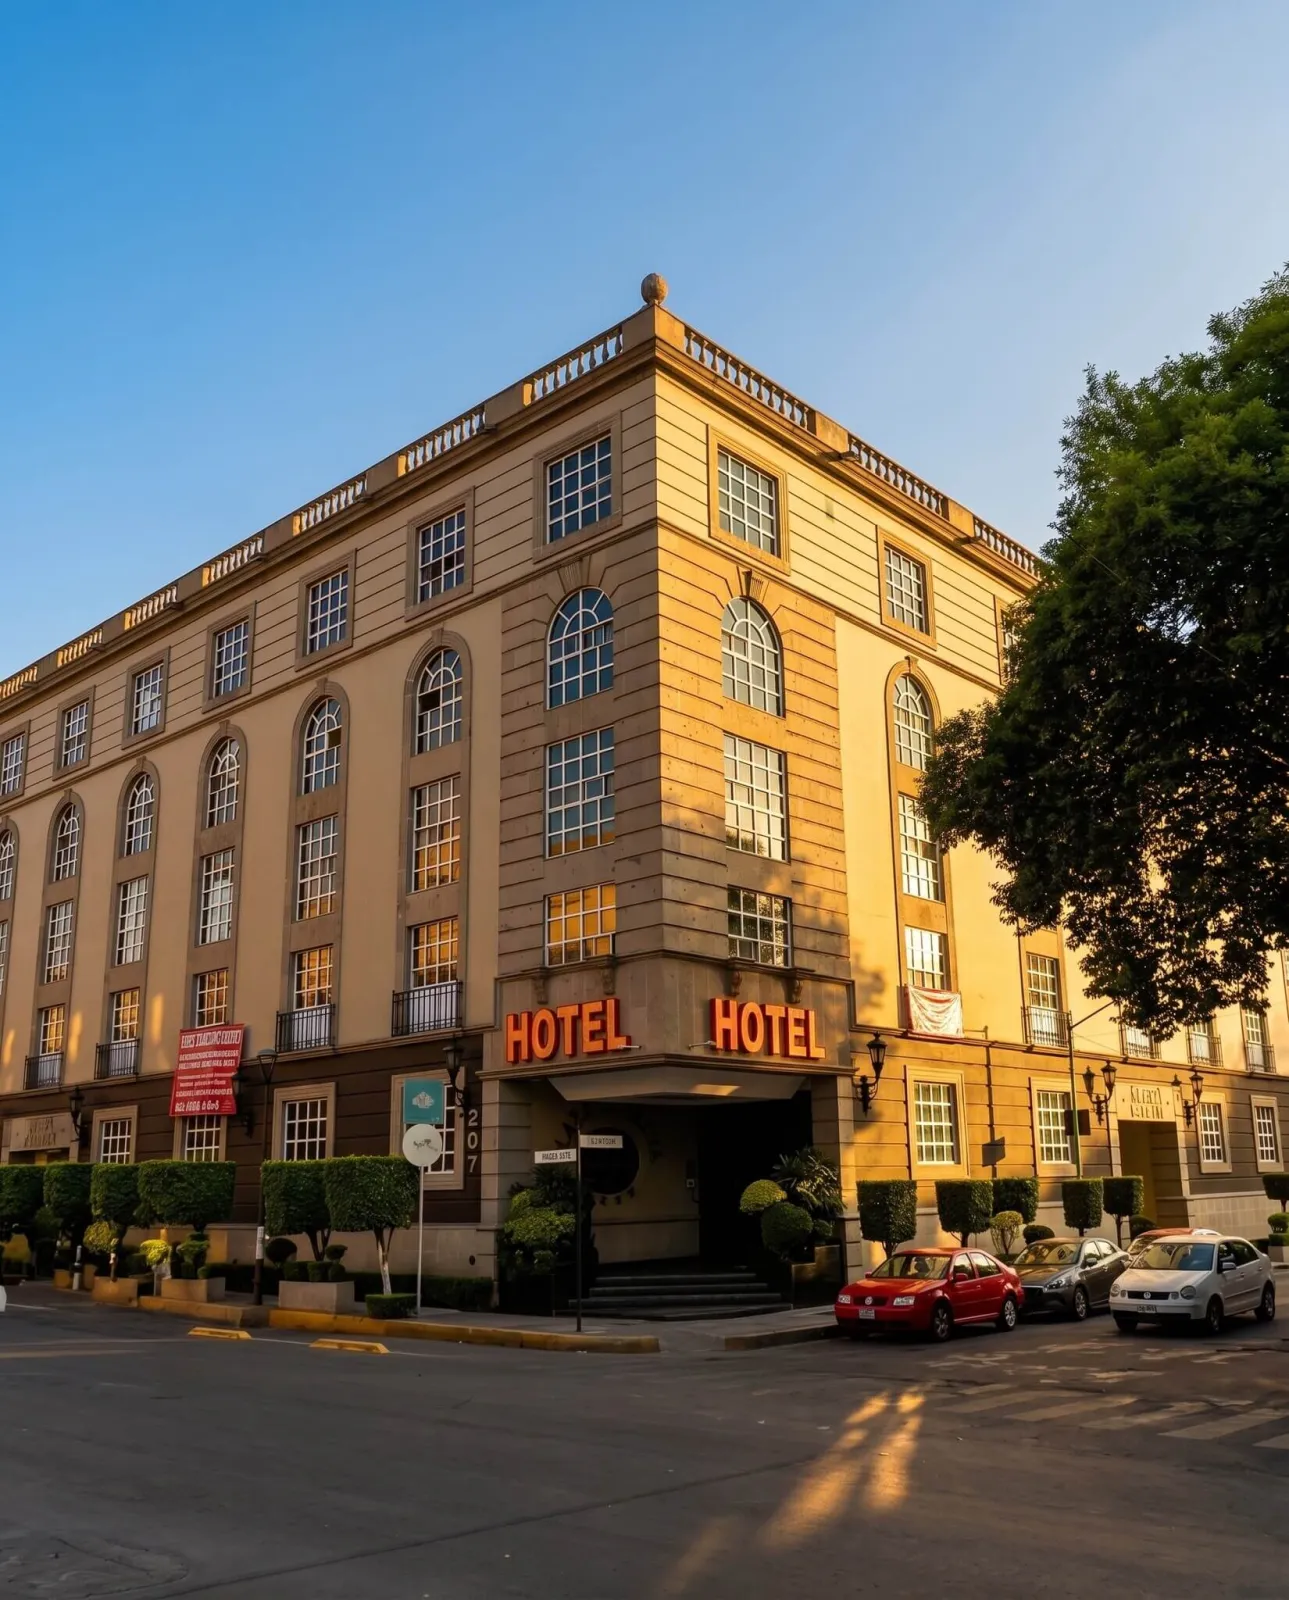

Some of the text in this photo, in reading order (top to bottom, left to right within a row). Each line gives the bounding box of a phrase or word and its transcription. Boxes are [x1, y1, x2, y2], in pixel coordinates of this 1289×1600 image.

[506, 998, 632, 1063] HOTEL
[710, 998, 826, 1060] HOTEL
[467, 1108, 479, 1173] 207
